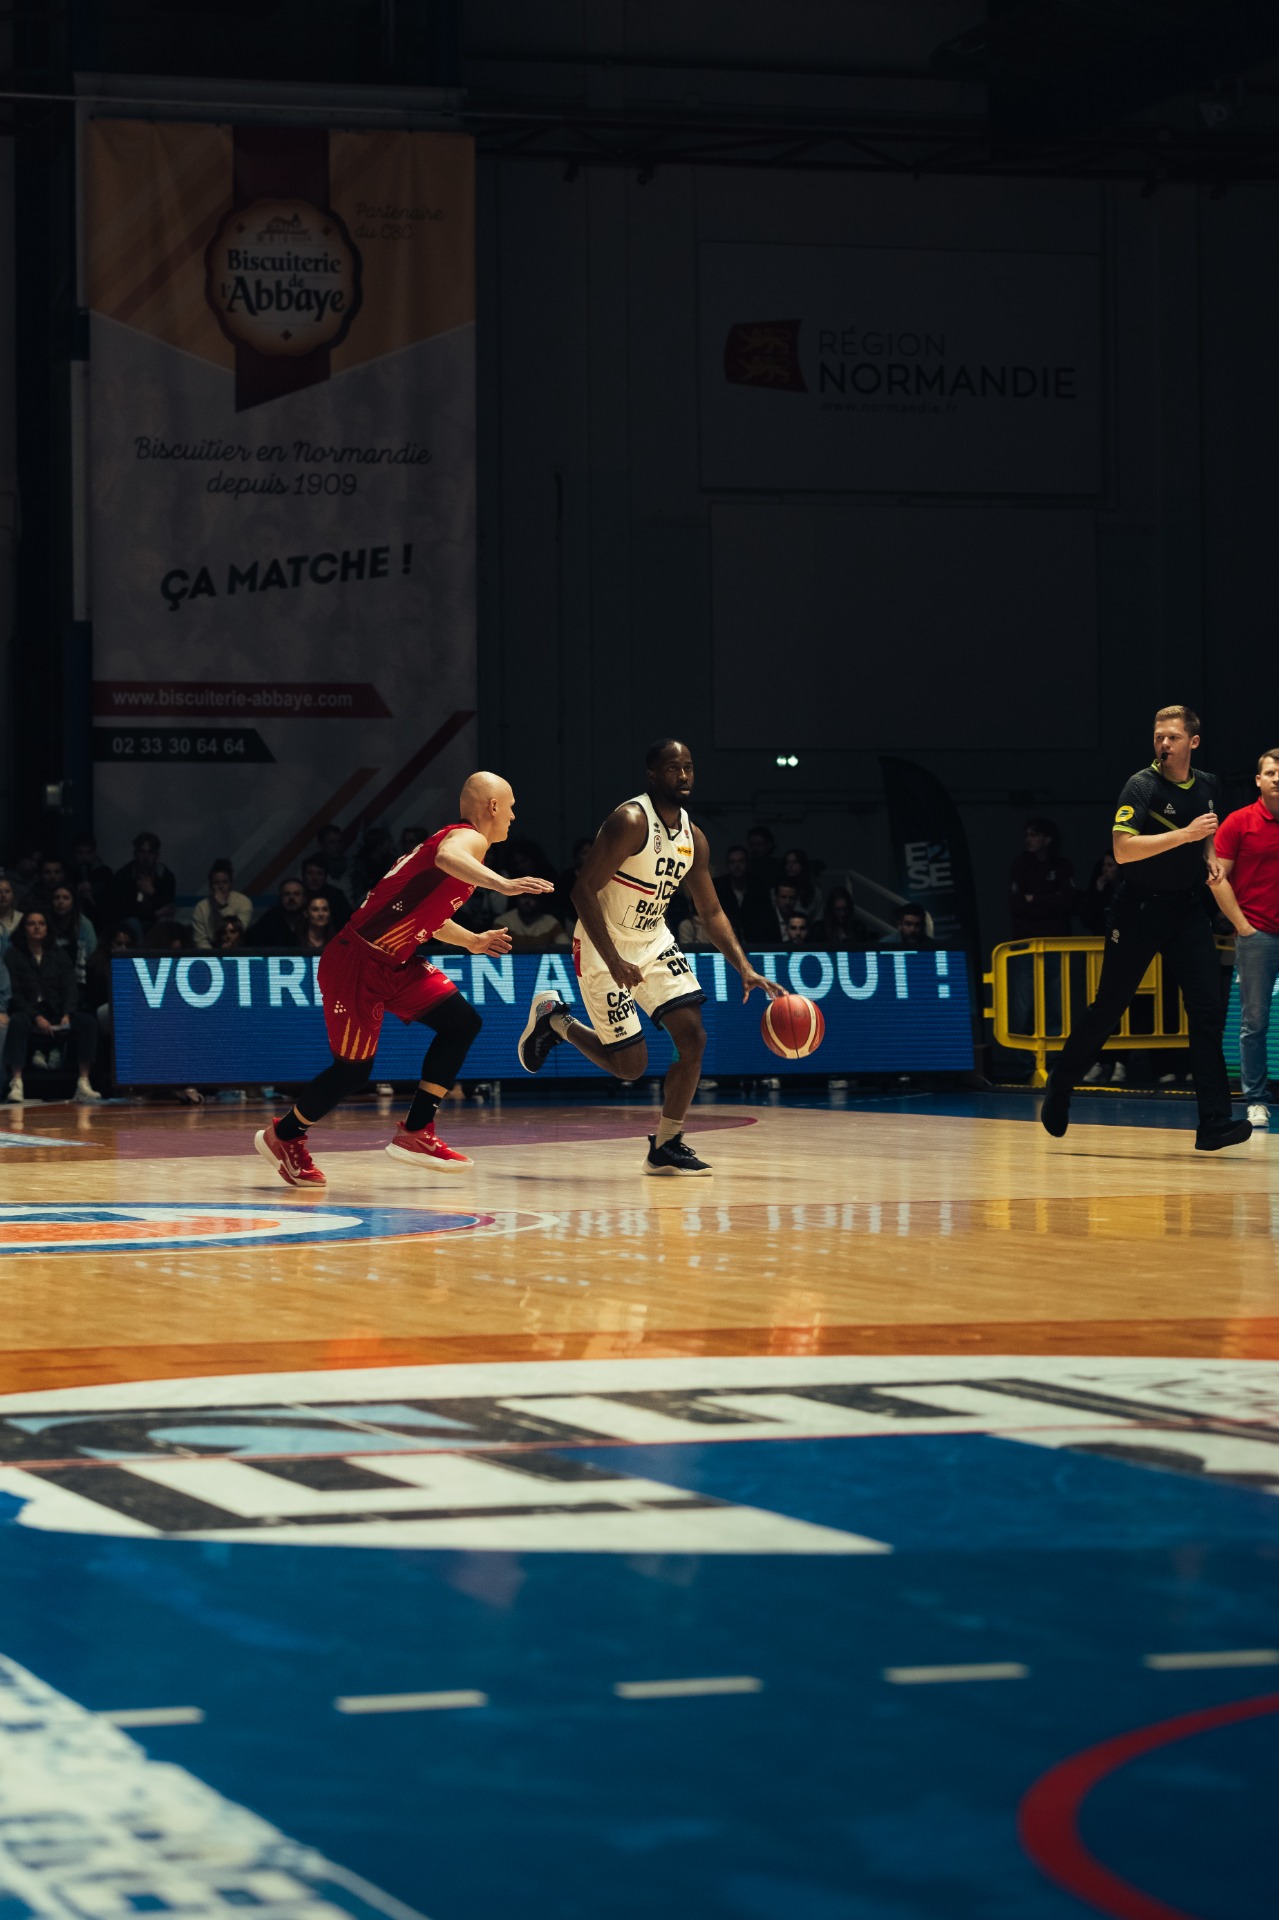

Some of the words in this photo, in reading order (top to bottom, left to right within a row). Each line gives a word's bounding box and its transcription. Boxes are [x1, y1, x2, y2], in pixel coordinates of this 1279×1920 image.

[354, 202, 446, 222] Partenaire
[354, 224, 378, 240] du
[380, 224, 415, 241] CBC
[227, 249, 342, 274] Biscuiterie
[287, 273, 305, 289] de
[818, 326, 946, 358] RÉGION
[818, 361, 1077, 400] NORMANDIE
[820, 401, 959, 415] www.normandie.fr
[134, 436, 251, 461] Biscuitier
[256, 444, 288, 463] en
[292, 440, 433, 465] Normandie
[206, 470, 289, 500] depuis
[293, 472, 358, 496] 1909
[160, 565, 217, 612] ÇA
[227, 546, 391, 596] MATCHE
[402, 543, 414, 575] !
[112, 688, 353, 711] www.biscuiterie-abbaye.com
[112, 737, 134, 754] 02
[140, 738, 163, 754] 33
[168, 738, 191, 755] 30
[196, 738, 217, 755] 64
[223, 738, 246, 755] 64
[655, 857, 686, 880] CBC
[748, 951, 919, 1001] TOUT
[935, 950, 951, 999] !
